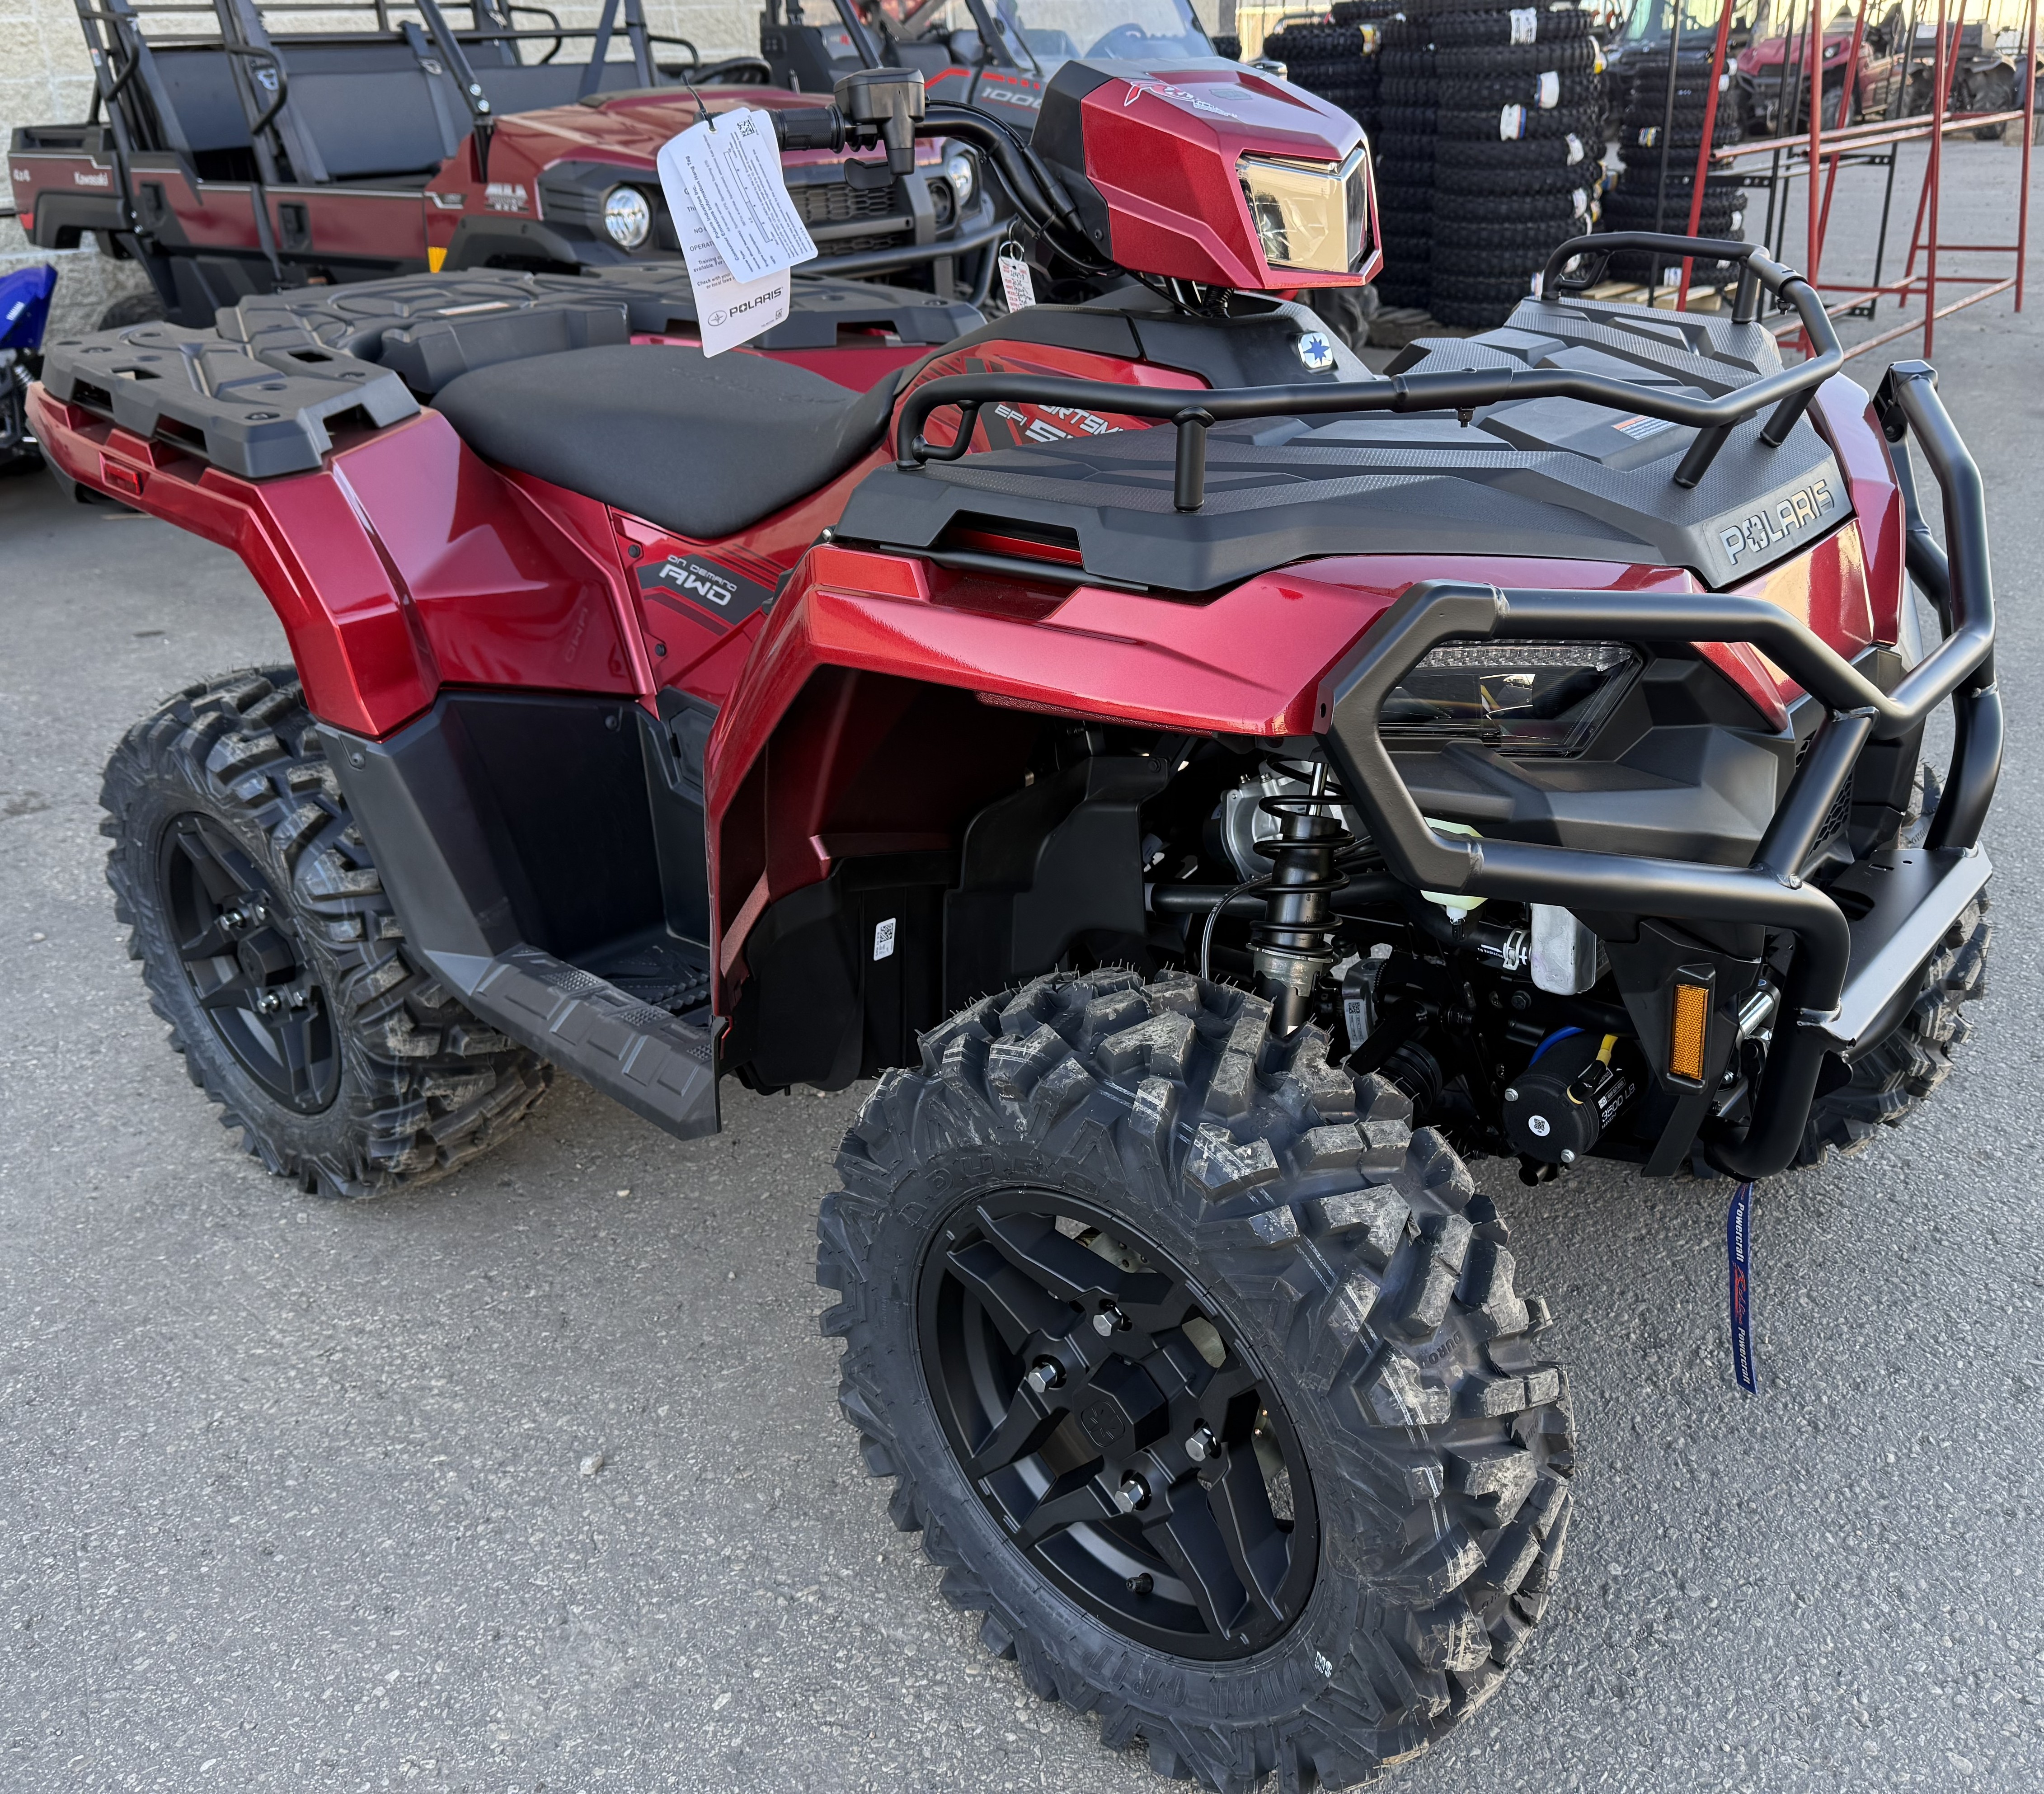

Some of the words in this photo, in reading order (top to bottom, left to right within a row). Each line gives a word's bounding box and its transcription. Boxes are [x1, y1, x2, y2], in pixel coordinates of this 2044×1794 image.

[689, 165, 699, 180] Hang
[695, 180, 712, 211] Information
[695, 195, 711, 221] Industries
[708, 221, 720, 239] Polaris
[709, 211, 726, 237] Emissions
[723, 236, 739, 261] Consumer
[728, 287, 783, 318] POLARIS
[994, 404, 1027, 426] EFI
[1038, 404, 1124, 435] ORTSM
[1719, 478, 1835, 565] POLARIS
[659, 563, 731, 606] AWD
[1602, 1097, 1623, 1122] 3500
[1624, 1083, 1635, 1100] LB
[1734, 1202, 1744, 1262] Powercraft
[1738, 1326, 1750, 1384] Powercraft
